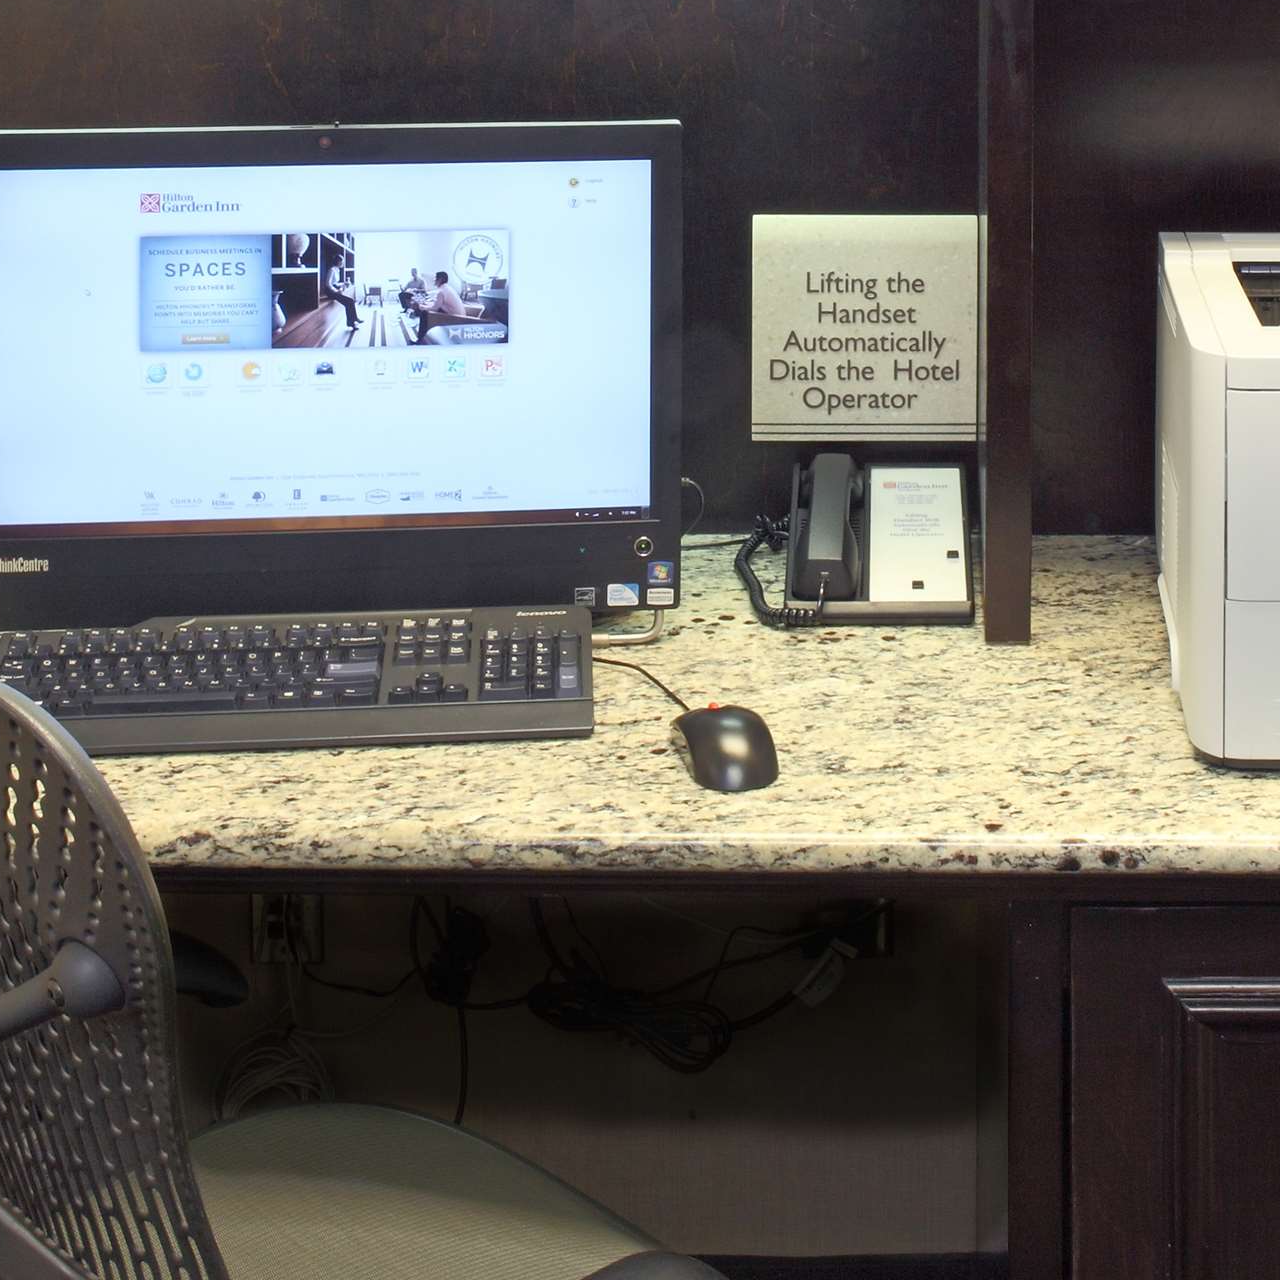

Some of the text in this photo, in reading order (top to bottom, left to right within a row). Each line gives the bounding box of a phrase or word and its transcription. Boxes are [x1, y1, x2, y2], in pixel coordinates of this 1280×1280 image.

[162, 193, 194, 202] Hilton
[162, 201, 240, 213] Garden Inn
[148, 248, 183, 256] SCHEDULE
[164, 262, 246, 277] SPACES
[806, 271, 925, 300] Lifting the
[817, 301, 917, 324] Handset
[464, 331, 505, 339] HHONORS
[783, 330, 946, 359] Automatically
[770, 359, 960, 381] Dials the Hotel
[803, 386, 918, 415] Operator
